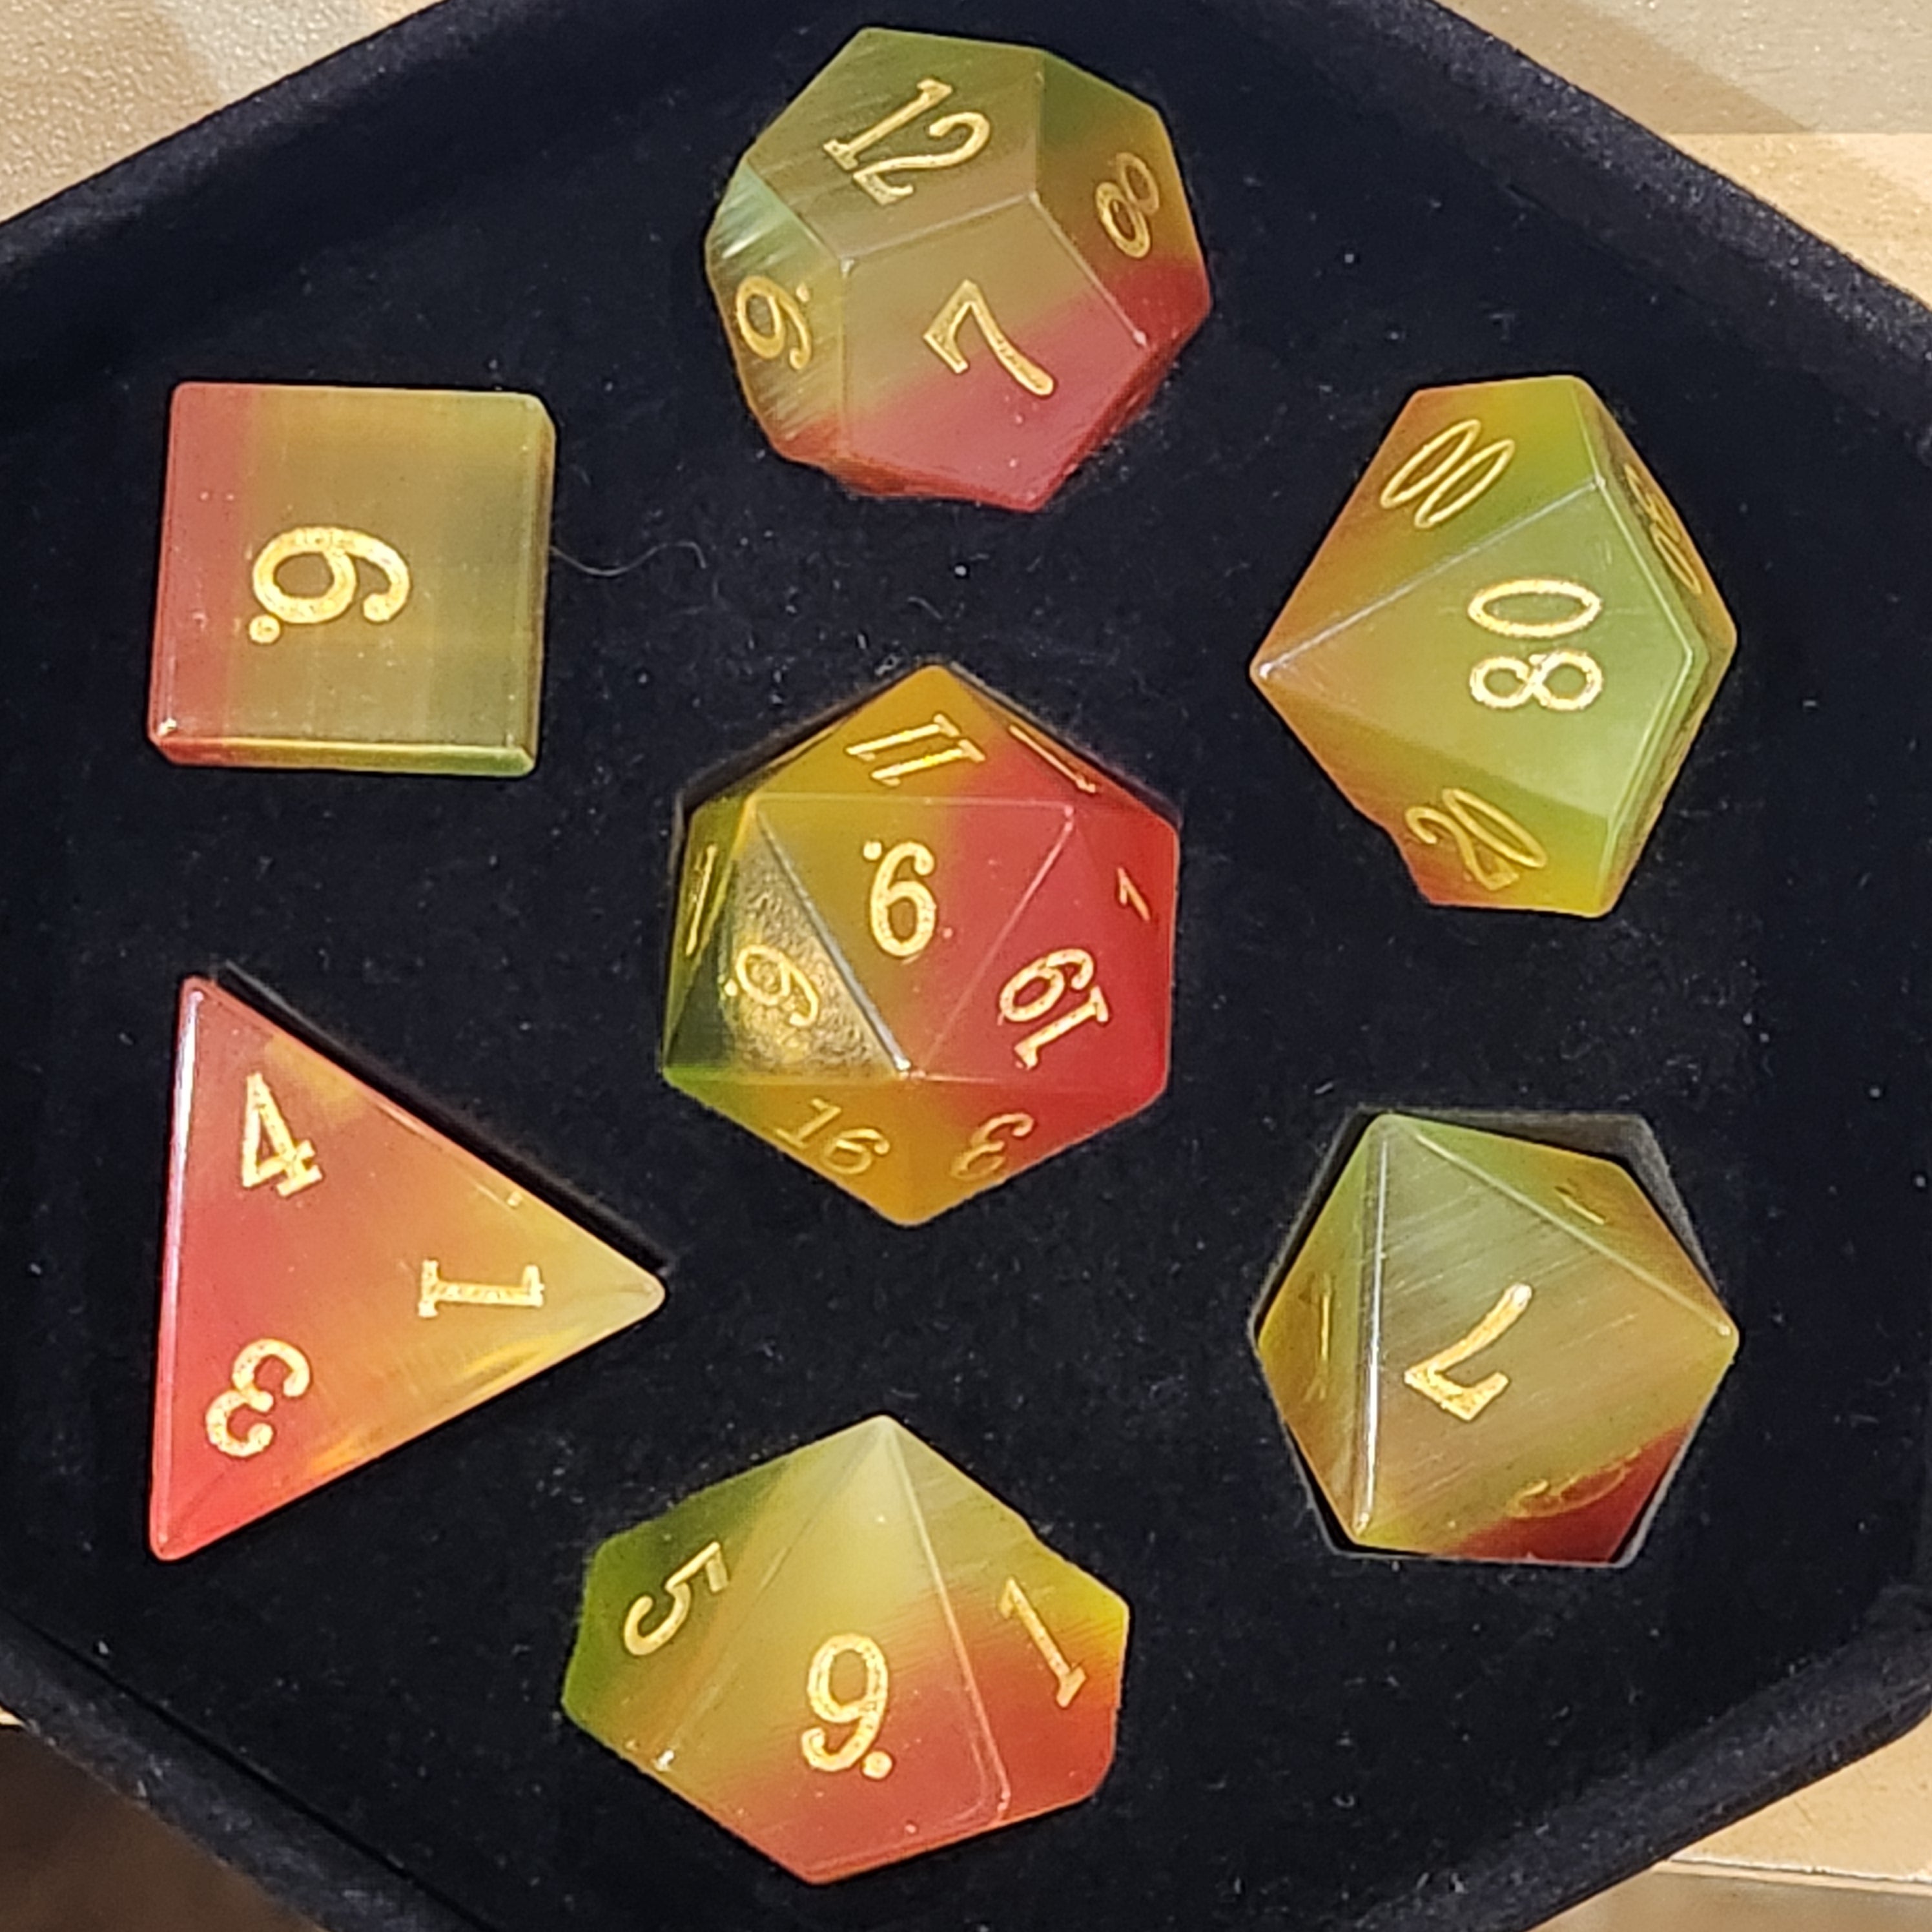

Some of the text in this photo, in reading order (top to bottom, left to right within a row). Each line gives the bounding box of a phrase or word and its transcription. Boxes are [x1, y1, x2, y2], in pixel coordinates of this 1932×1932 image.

[823, 78, 991, 205] 12
[1095, 152, 1159, 258] 8
[924, 279, 1053, 396] 7
[1380, 419, 1516, 529] 00
[1468, 579, 1603, 711] 80
[846, 714, 986, 786] 11
[1406, 787, 1547, 890] 20
[1000, 948, 1109, 1069] 19
[242, 1072, 323, 1198] 4
[775, 1098, 890, 1175] 16
[951, 1113, 1034, 1182] 3
[417, 1259, 544, 1319] 1
[204, 1338, 311, 1458] 3
[1404, 1283, 1533, 1422] 7
[623, 1541, 730, 1657] 5
[998, 1576, 1087, 1709] 1
